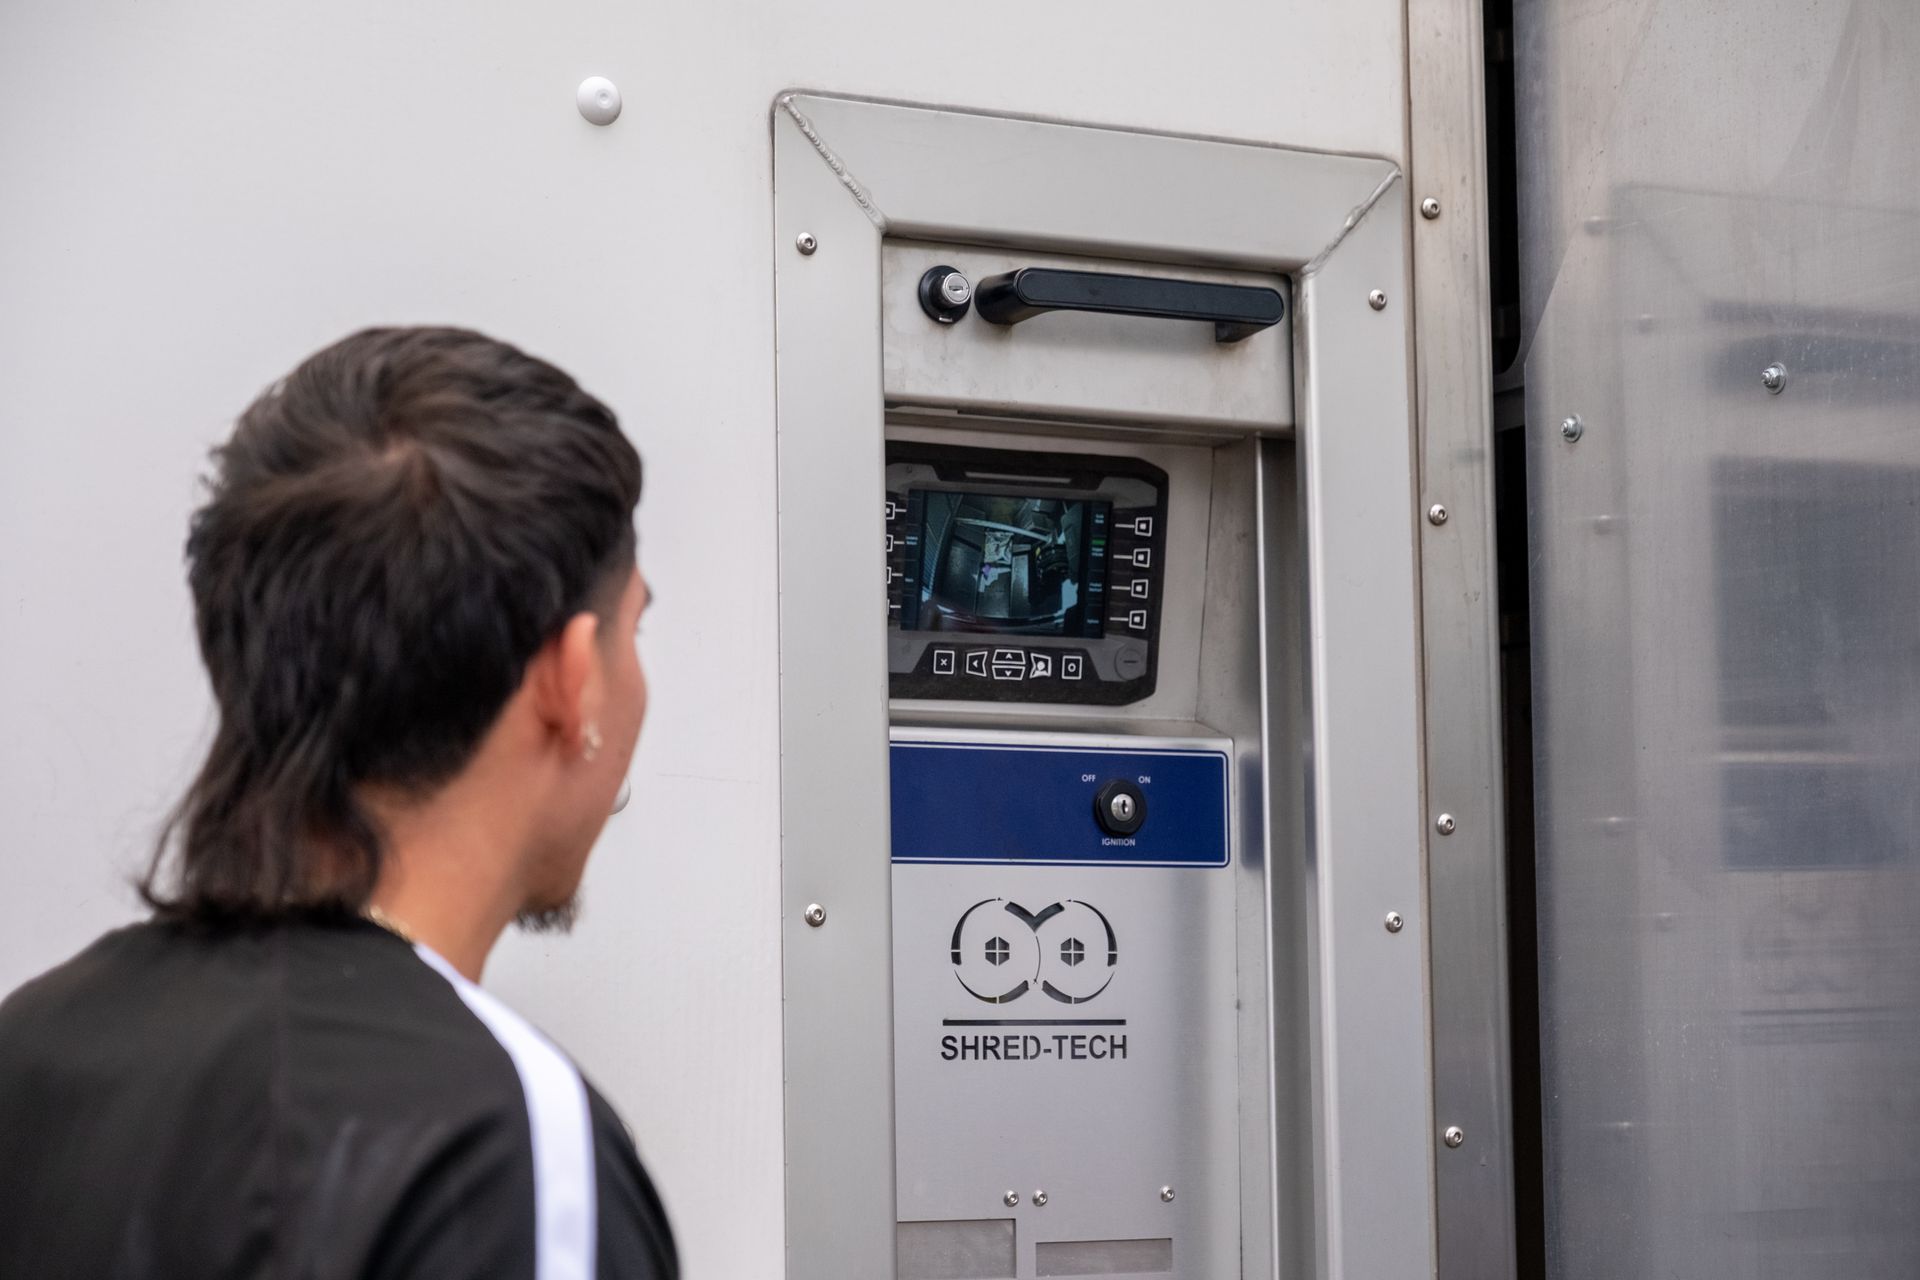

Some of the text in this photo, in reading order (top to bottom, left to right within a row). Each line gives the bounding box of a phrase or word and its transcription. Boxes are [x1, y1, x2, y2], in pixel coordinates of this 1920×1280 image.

[1081, 774, 1096, 783] OFF
[1138, 775, 1151, 784] ON
[1101, 838, 1136, 847] IGNITION
[940, 1034, 1127, 1061] SHRED-TECH
